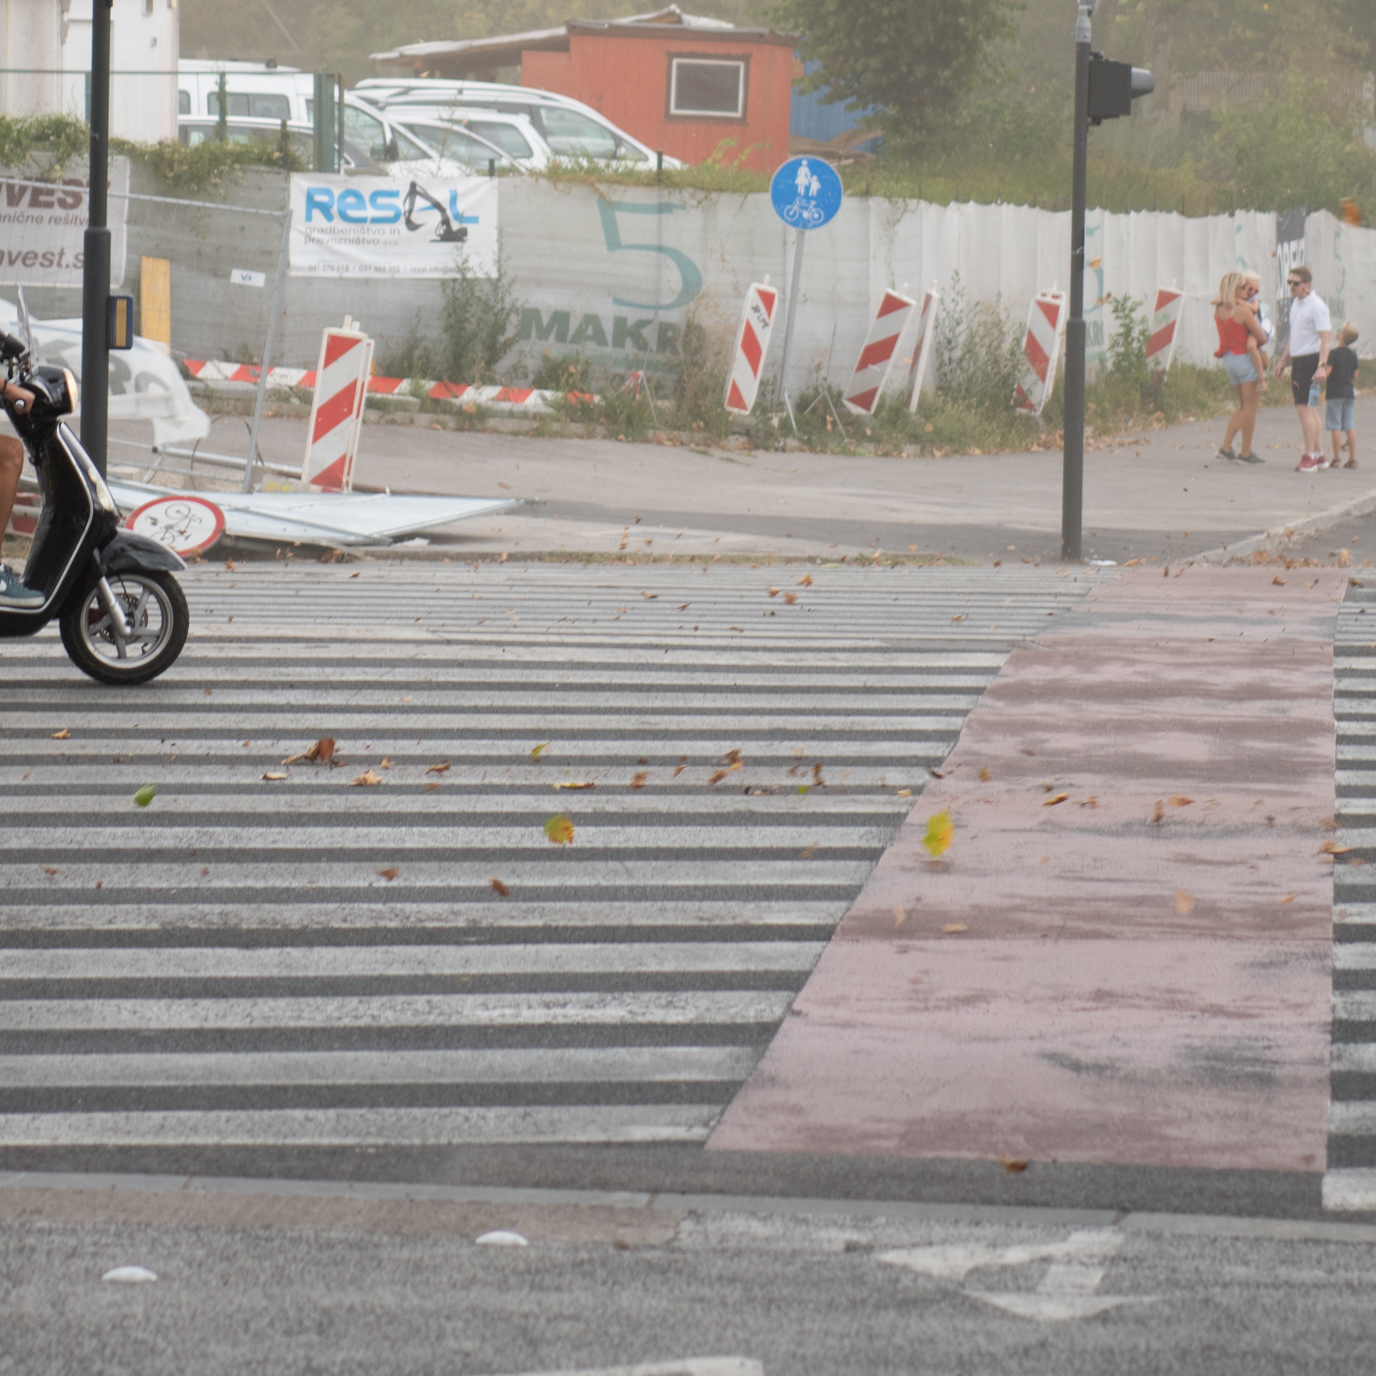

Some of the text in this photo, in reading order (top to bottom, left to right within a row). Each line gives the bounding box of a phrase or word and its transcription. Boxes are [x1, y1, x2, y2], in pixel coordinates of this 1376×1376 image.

[48, 213, 90, 225] rešitv
[305, 225, 401, 238] gradbeništvo in
[304, 235, 380, 246] prevozništvo
[596, 198, 703, 311] 5
[516, 307, 706, 354] MAKR
